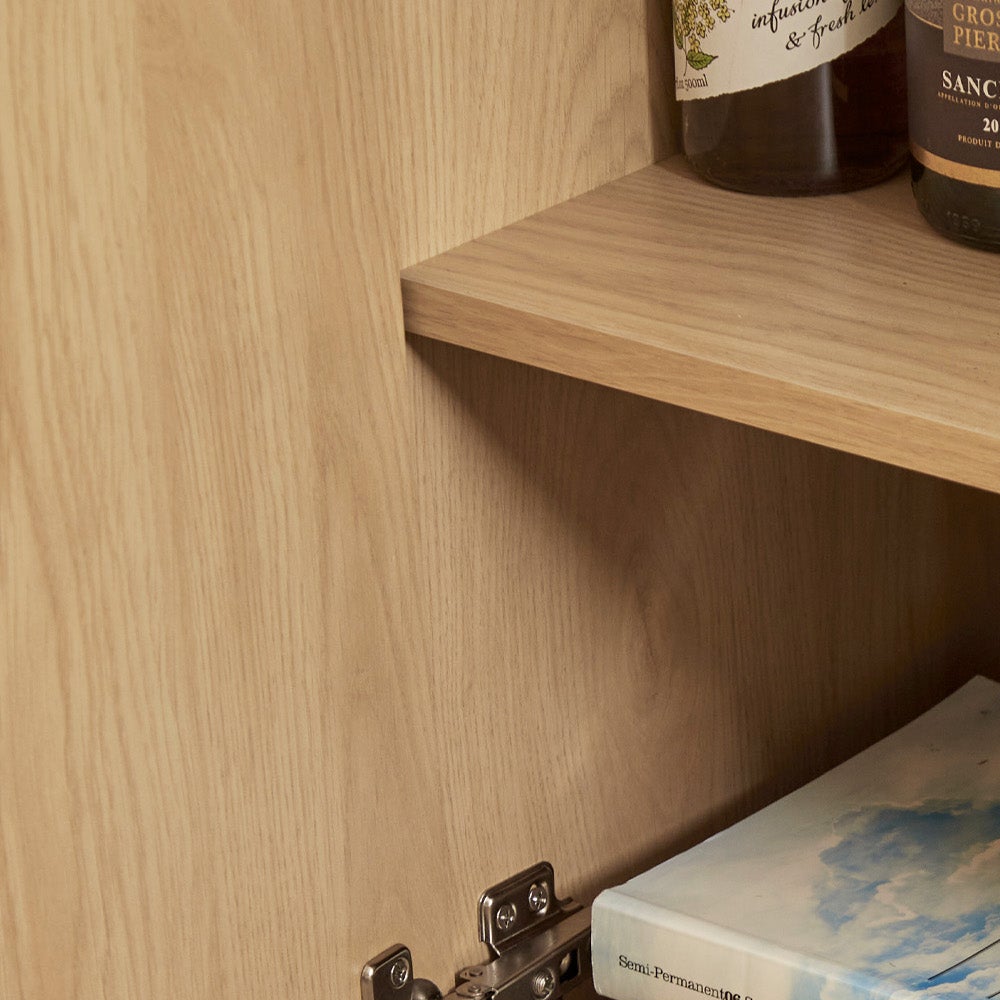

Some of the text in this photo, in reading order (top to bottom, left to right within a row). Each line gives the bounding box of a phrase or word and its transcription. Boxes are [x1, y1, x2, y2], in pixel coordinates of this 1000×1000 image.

[752, 0, 826, 33] infusion
[785, 32, 806, 51] &
[808, 1, 855, 49] fresh
[937, 91, 982, 108] APPELLATION
[957, 134, 992, 148] PRODUIT
